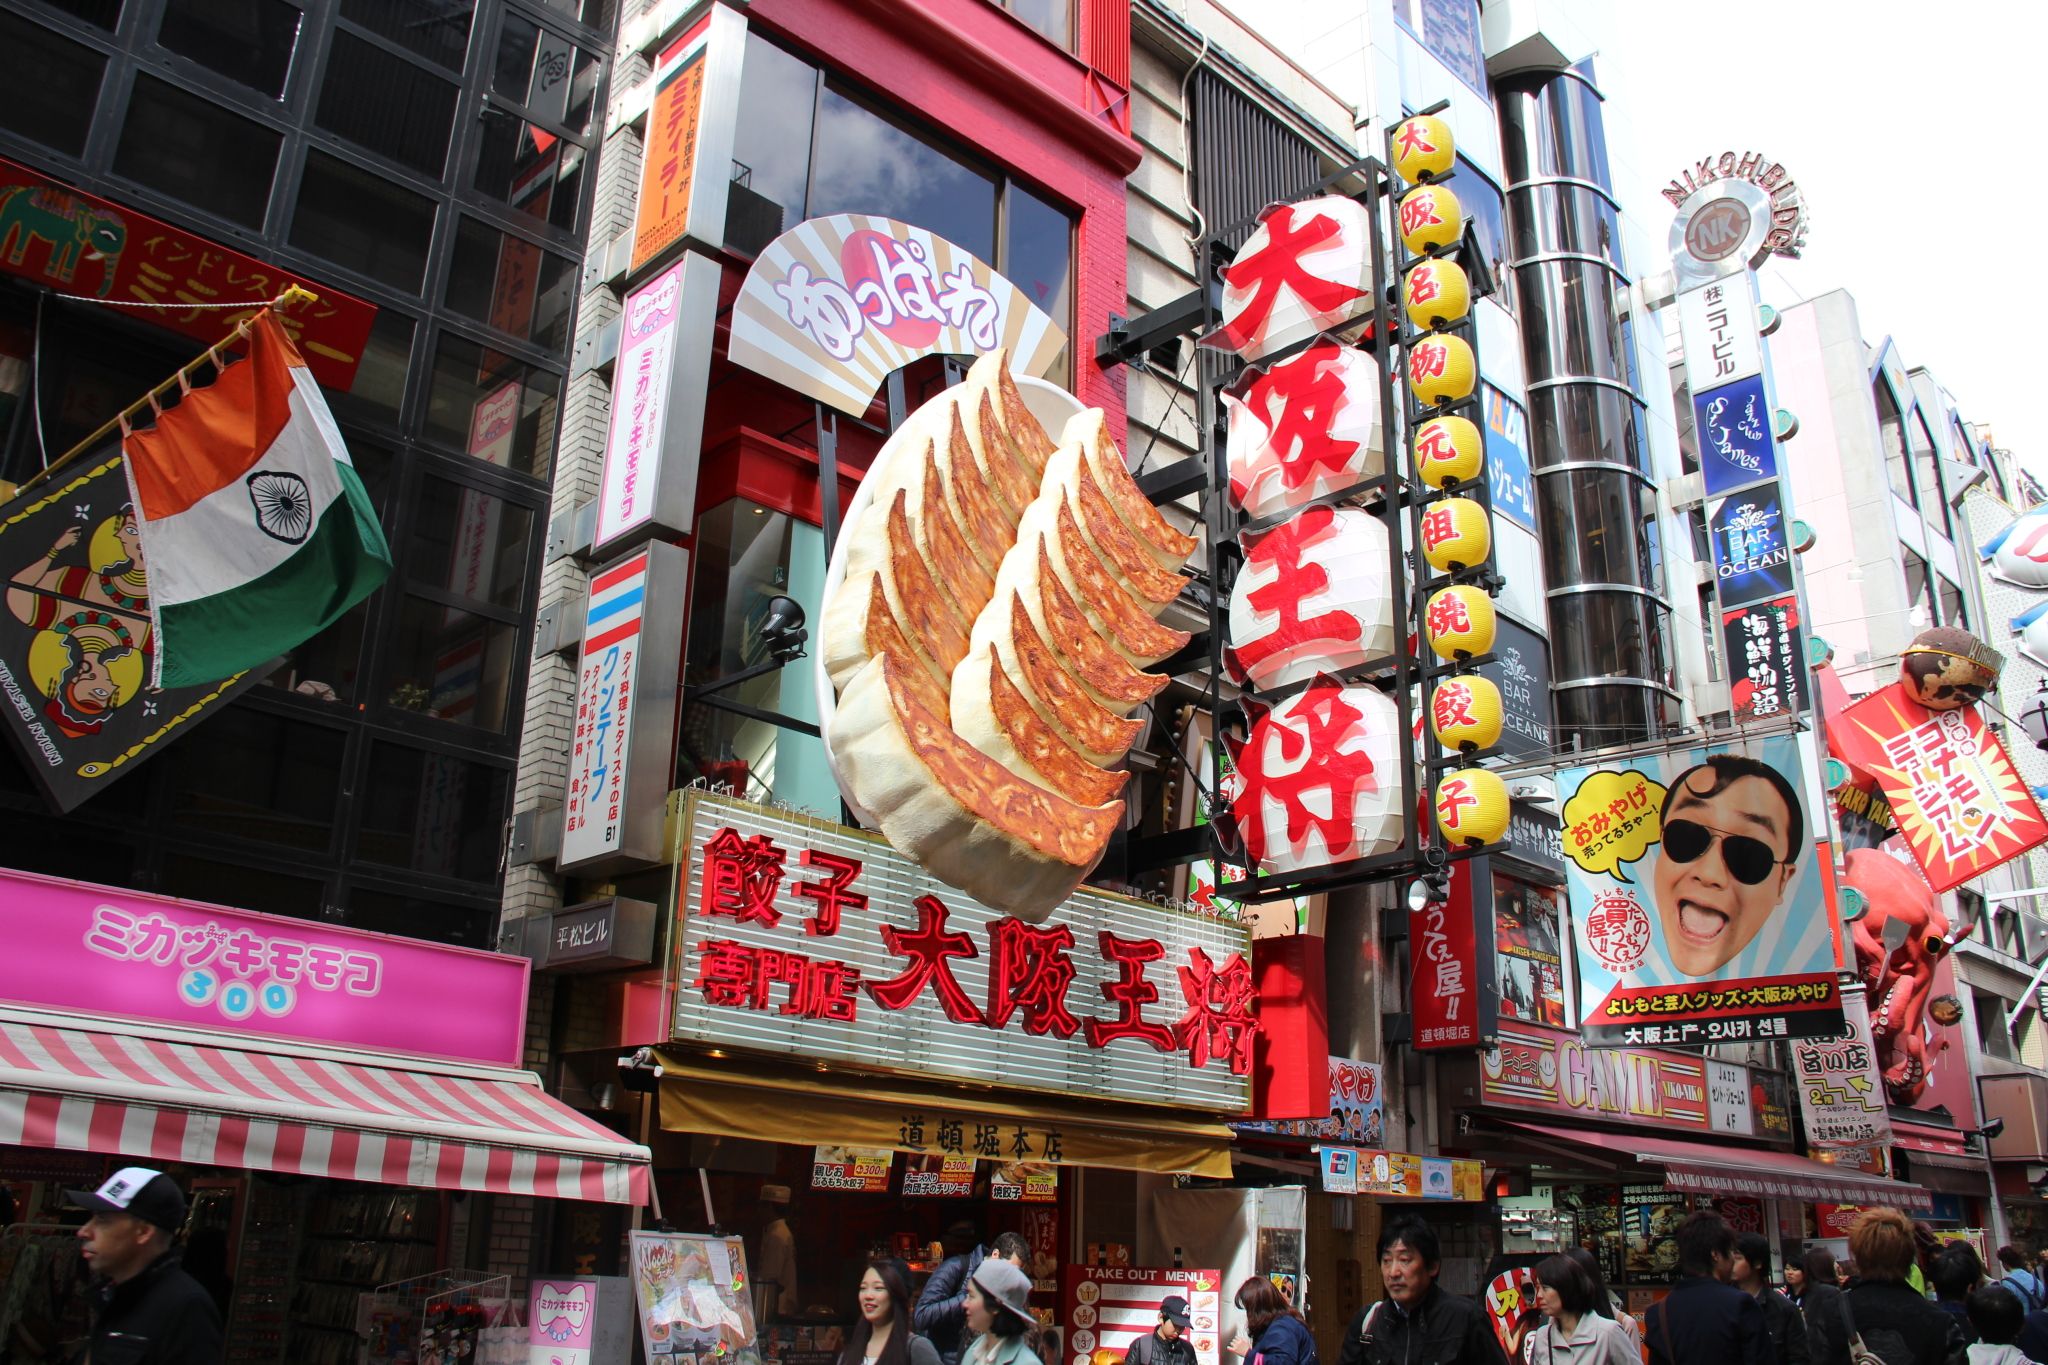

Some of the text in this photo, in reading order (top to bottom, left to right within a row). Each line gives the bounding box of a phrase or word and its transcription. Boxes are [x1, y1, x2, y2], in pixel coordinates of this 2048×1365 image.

[660, 77, 689, 219] ミティラー
[1661, 151, 1801, 250] NIKOH BLDG
[1698, 214, 1738, 251] NK
[774, 237, 1000, 362] あっぱれ
[620, 349, 654, 521] ミカヅキモモコ
[1713, 426, 1760, 469] James
[1398, 121, 1477, 834] 大阪名物元祖焼餃子
[1728, 528, 1770, 551] BAR
[1719, 547, 1788, 579] OCEAN
[1742, 613, 1780, 717] 海鮮物語
[1503, 679, 1531, 707] BAR
[27, 722, 64, 767] INDIAN
[591, 645, 620, 803] クンテープ
[567, 669, 591, 833] タイ調味料 食材店
[577, 664, 600, 829] タイカルチャースクール
[604, 650, 632, 843] タイ料理とタイスキの店 B1
[1569, 781, 1649, 848] おみやげ
[1867, 797, 1893, 829] YAK
[1886, 734, 1974, 858] ミュージアム
[700, 826, 869, 938] 餃子
[1594, 887, 1635, 903] よしもと
[86, 905, 381, 996] ミカヅキモモコ
[556, 915, 608, 951] 平松ビル
[185, 971, 288, 1013] 300
[694, 939, 862, 1024] 専門店
[858, 894, 1267, 1077] 大阪王将
[1420, 1025, 1470, 1043] 道頓堀店
[1757, 1017, 1788, 1036] 선물
[1502, 1074, 1542, 1087] GAME HOUSE
[1503, 1047, 1540, 1076] ニコニコ
[1559, 1039, 1663, 1118] GAME
[1717, 1065, 1737, 1083] JAZZ
[1799, 1044, 1870, 1075] 旨い店
[1661, 1080, 1704, 1103] NIKO-NIKO
[897, 1114, 1065, 1163] 道頓堀本店
[1726, 1113, 1737, 1130] 4F
[902, 1182, 971, 1196] 肉団子のチリソース
[904, 1172, 939, 1184] チーズ入り
[992, 1185, 1022, 1200] 焼餃子
[1539, 1188, 1550, 1198] 4F
[1086, 1267, 1204, 1283] TAKE OUT MENU
